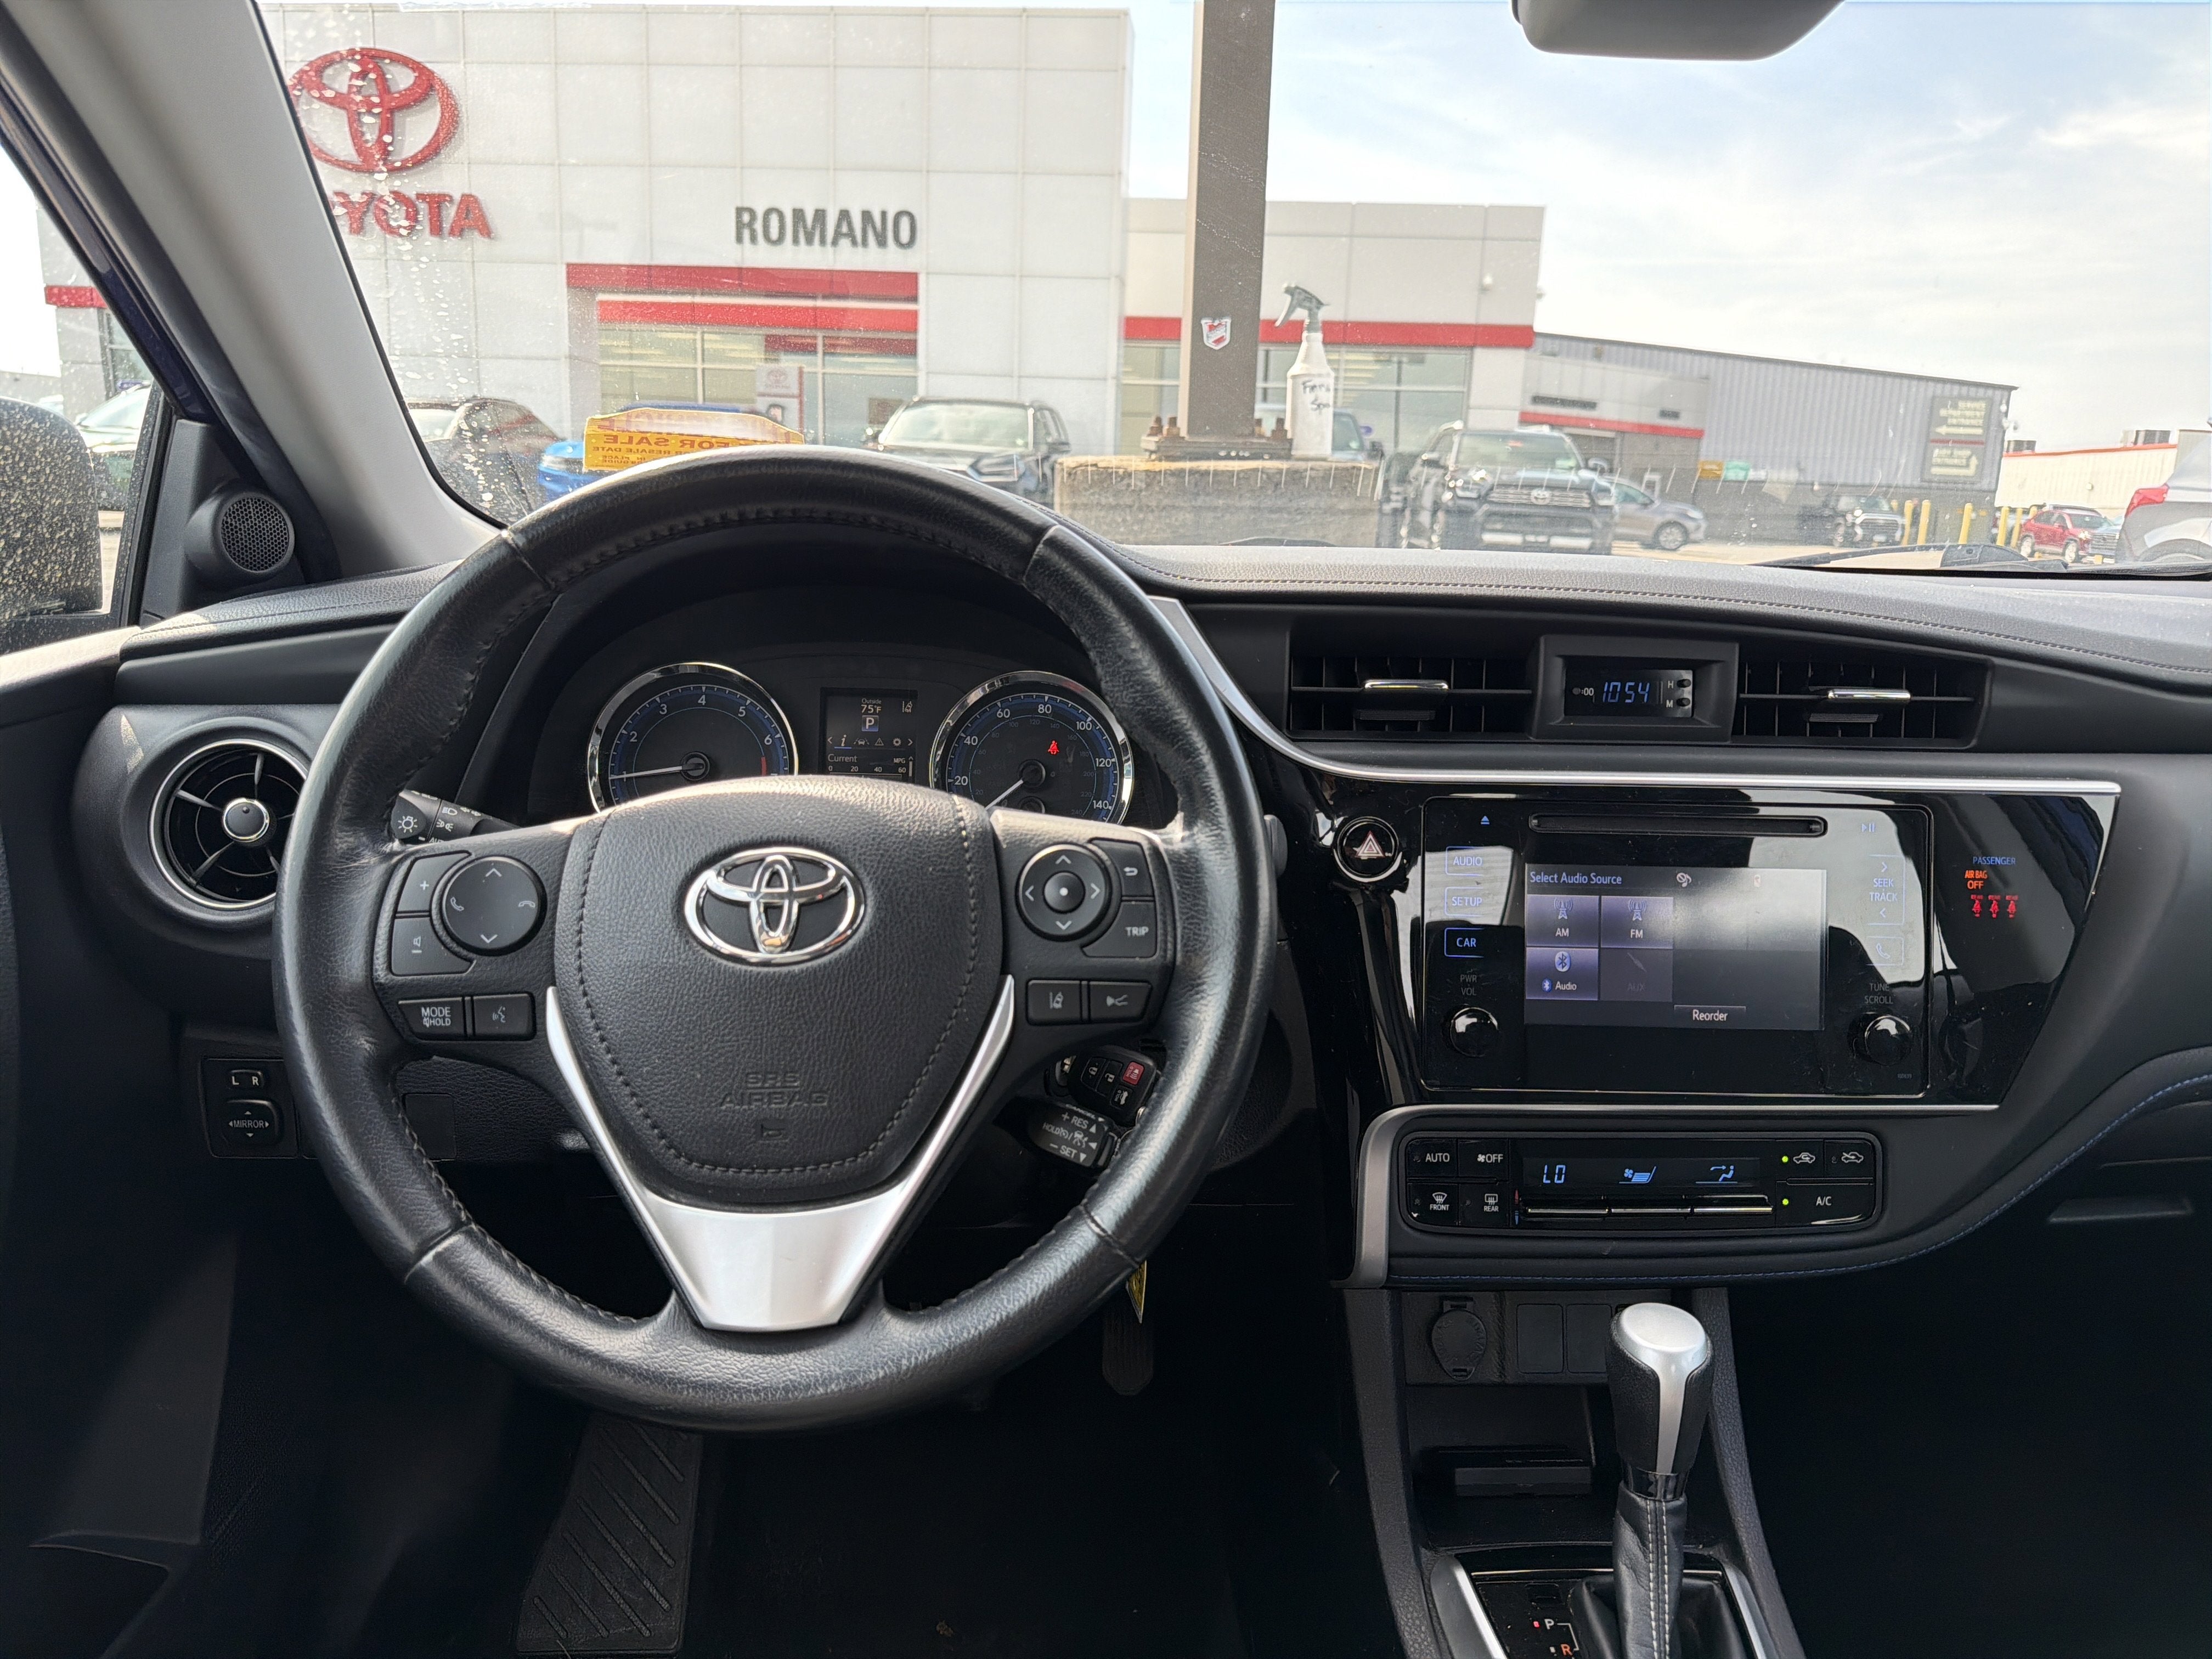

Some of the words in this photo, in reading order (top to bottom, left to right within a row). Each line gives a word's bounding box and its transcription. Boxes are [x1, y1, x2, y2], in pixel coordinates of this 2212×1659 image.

[330, 190, 493, 239] YOTA
[735, 206, 917, 250] ROMANO
[1668, 681, 1674, 689] H
[697, 695, 706, 706] 4
[1666, 699, 1673, 708] M
[659, 704, 667, 714] 3
[738, 706, 746, 717] 5
[996, 708, 1011, 718] 60
[1038, 704, 1052, 714] 80
[866, 717, 874, 729] P
[1076, 721, 1092, 731] 100
[629, 731, 637, 742] 2
[764, 734, 772, 746] 6
[964, 736, 978, 746] 40
[828, 753, 857, 763] Current
[1096, 758, 1111, 768] 120
[954, 776, 968, 786] 20
[1093, 800, 1109, 809] 140
[1453, 856, 1482, 866] AUDIO
[1972, 856, 2016, 865] PASSENGER
[1530, 871, 1558, 884] Select
[1560, 872, 1588, 884] Audio
[1590, 873, 1622, 885] Source
[1965, 870, 1974, 879] AIR
[1975, 870, 1988, 879] BAG
[1873, 878, 1894, 887] SEEK
[1967, 880, 1984, 889] OFF
[1452, 896, 1482, 906] SETUP
[1869, 892, 1898, 902] TRACK
[1125, 926, 1149, 936] TRIP
[1555, 927, 1570, 938] AM
[1630, 929, 1644, 939] FM
[1456, 937, 1476, 947] CAR
[1460, 974, 1477, 983] PWR
[1555, 981, 1577, 991] Audio
[1869, 983, 1890, 992] TUNE
[1461, 988, 1477, 996] VOL
[1864, 995, 1893, 1005] SCROLL
[421, 1007, 451, 1017] MODE
[1692, 1009, 1728, 1022] Reorder
[429, 1017, 451, 1026] HOLD
[232, 1076, 240, 1085] L
[252, 1076, 259, 1086] R
[233, 1120, 264, 1128] MIRROR
[1070, 1115, 1089, 1129] RES
[1043, 1122, 1060, 1135] HOLD
[1059, 1145, 1078, 1159] SET
[1425, 1153, 1450, 1163] AUTO
[1486, 1154, 1504, 1163] OFF
[1543, 1164, 1566, 1184] LO
[1816, 1197, 1832, 1206] A/C
[1544, 1619, 1555, 1629] P
[1561, 1644, 1573, 1656] R
